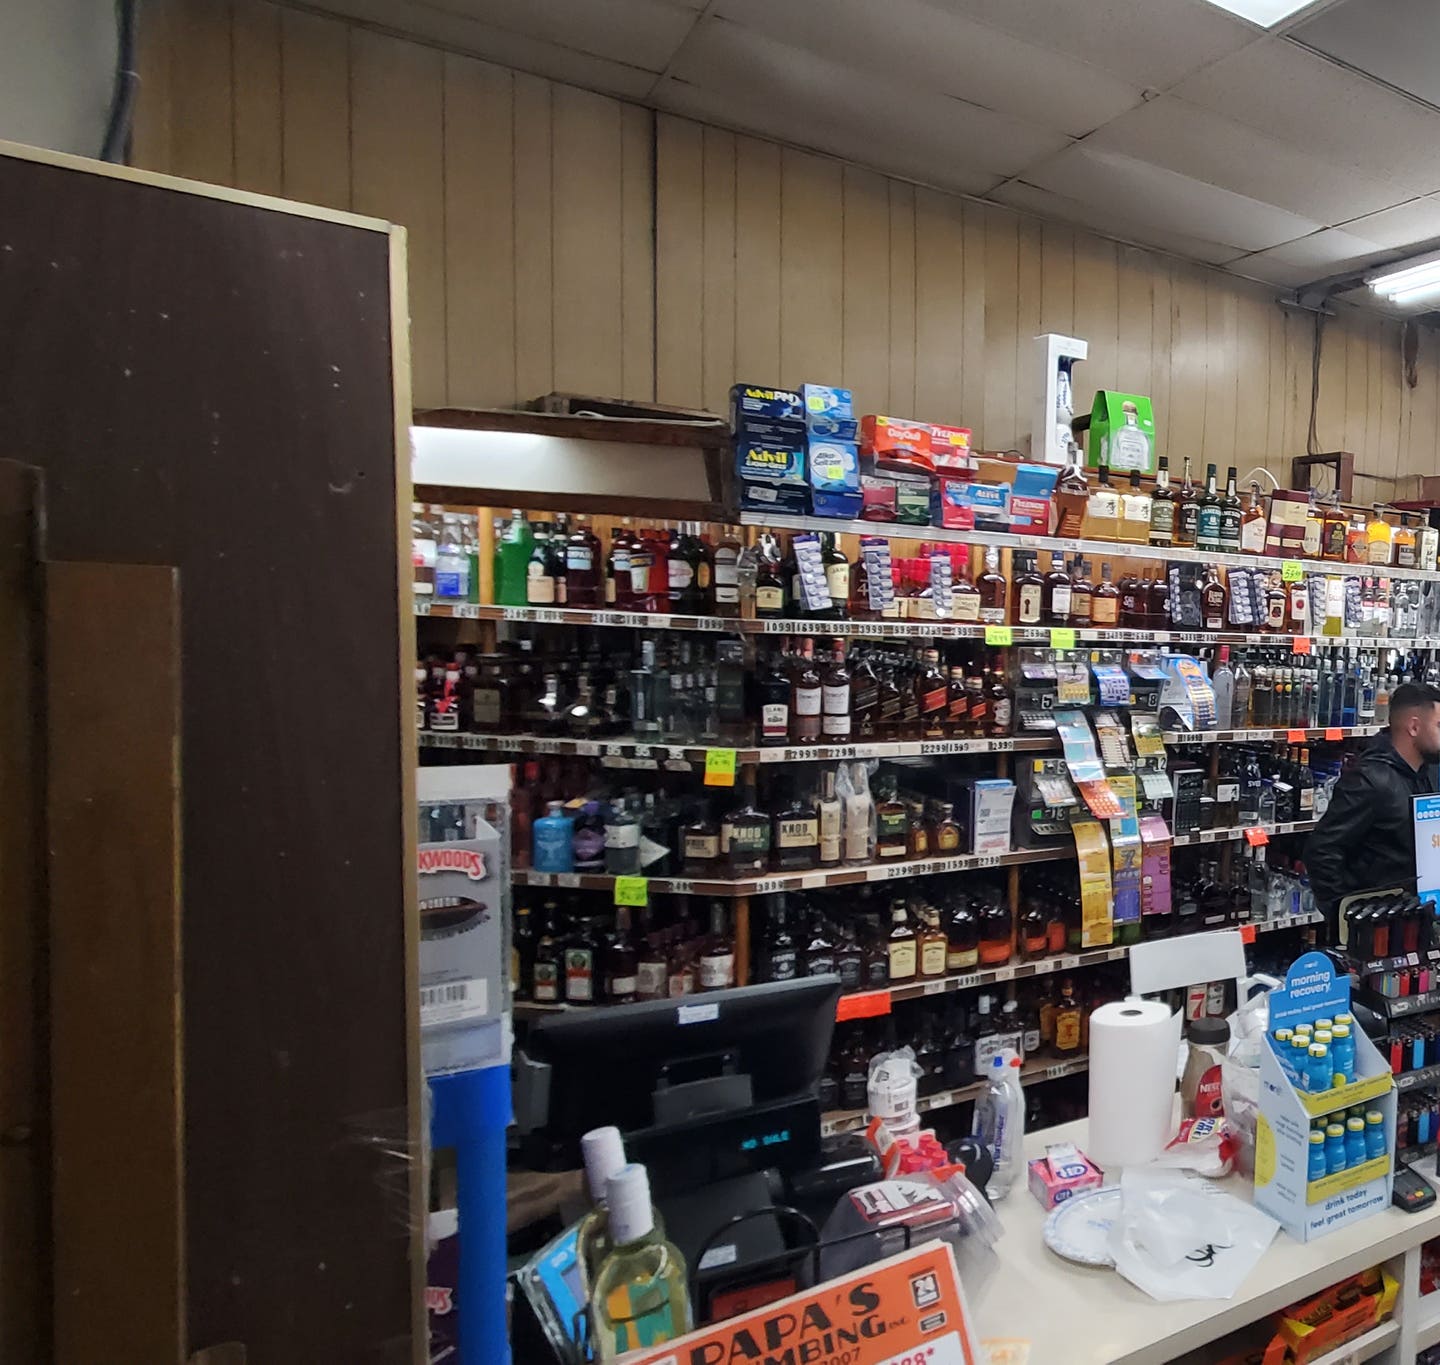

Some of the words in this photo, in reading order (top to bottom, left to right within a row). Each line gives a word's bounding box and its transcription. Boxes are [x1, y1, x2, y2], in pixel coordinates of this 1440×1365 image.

[746, 449, 788, 464] Advil
[780, 824, 807, 834] KNOB
[1291, 971, 1331, 987] morning
[1325, 1197, 1345, 1211] drink
[1346, 1189, 1368, 1201] today
[1310, 1217, 1325, 1229] feel
[1326, 1211, 1347, 1226] great
[1347, 1195, 1384, 1214] tomorrow
[689, 1282, 881, 1365] PAPA'S
[760, 1314, 887, 1365] MBING
